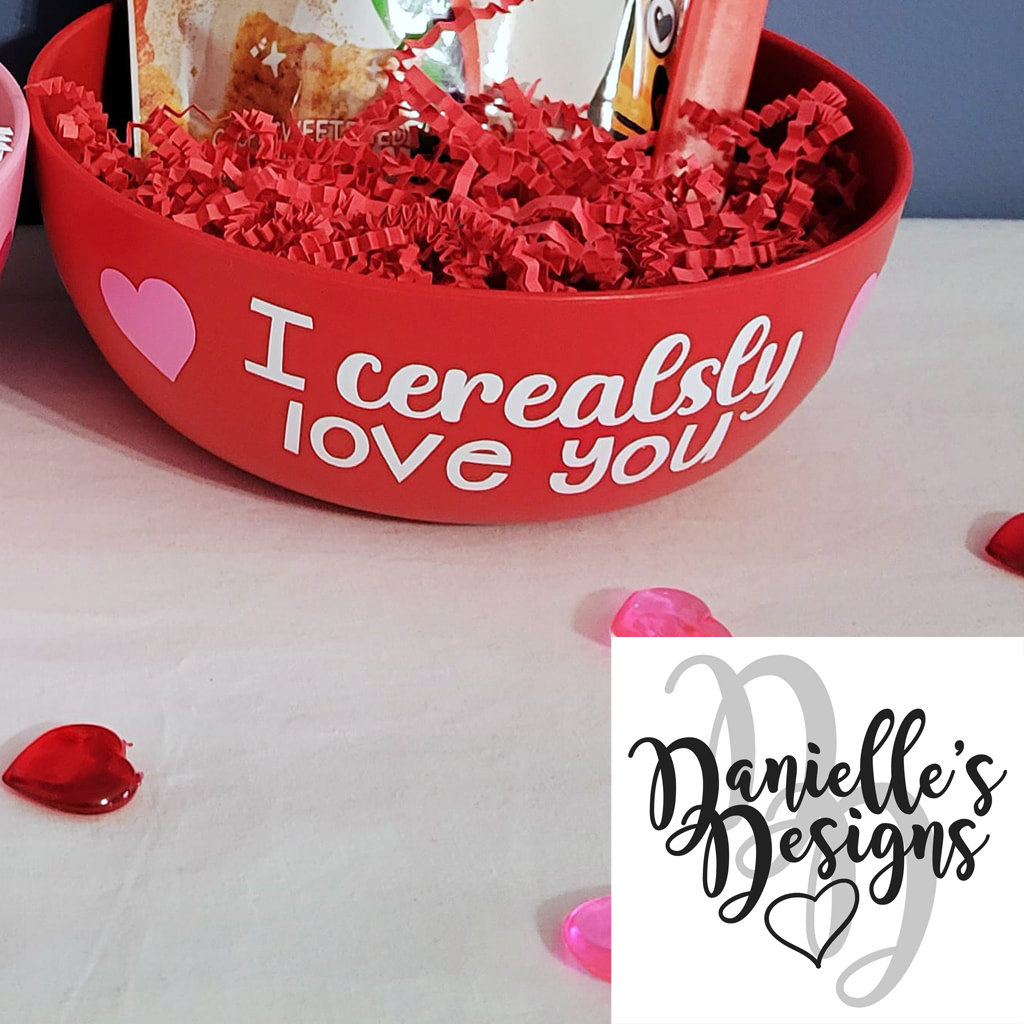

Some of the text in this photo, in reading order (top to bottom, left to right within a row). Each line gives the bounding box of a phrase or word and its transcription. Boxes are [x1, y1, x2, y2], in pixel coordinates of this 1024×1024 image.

[244, 297, 804, 429] I cerealsly
[284, 401, 733, 495] love you
